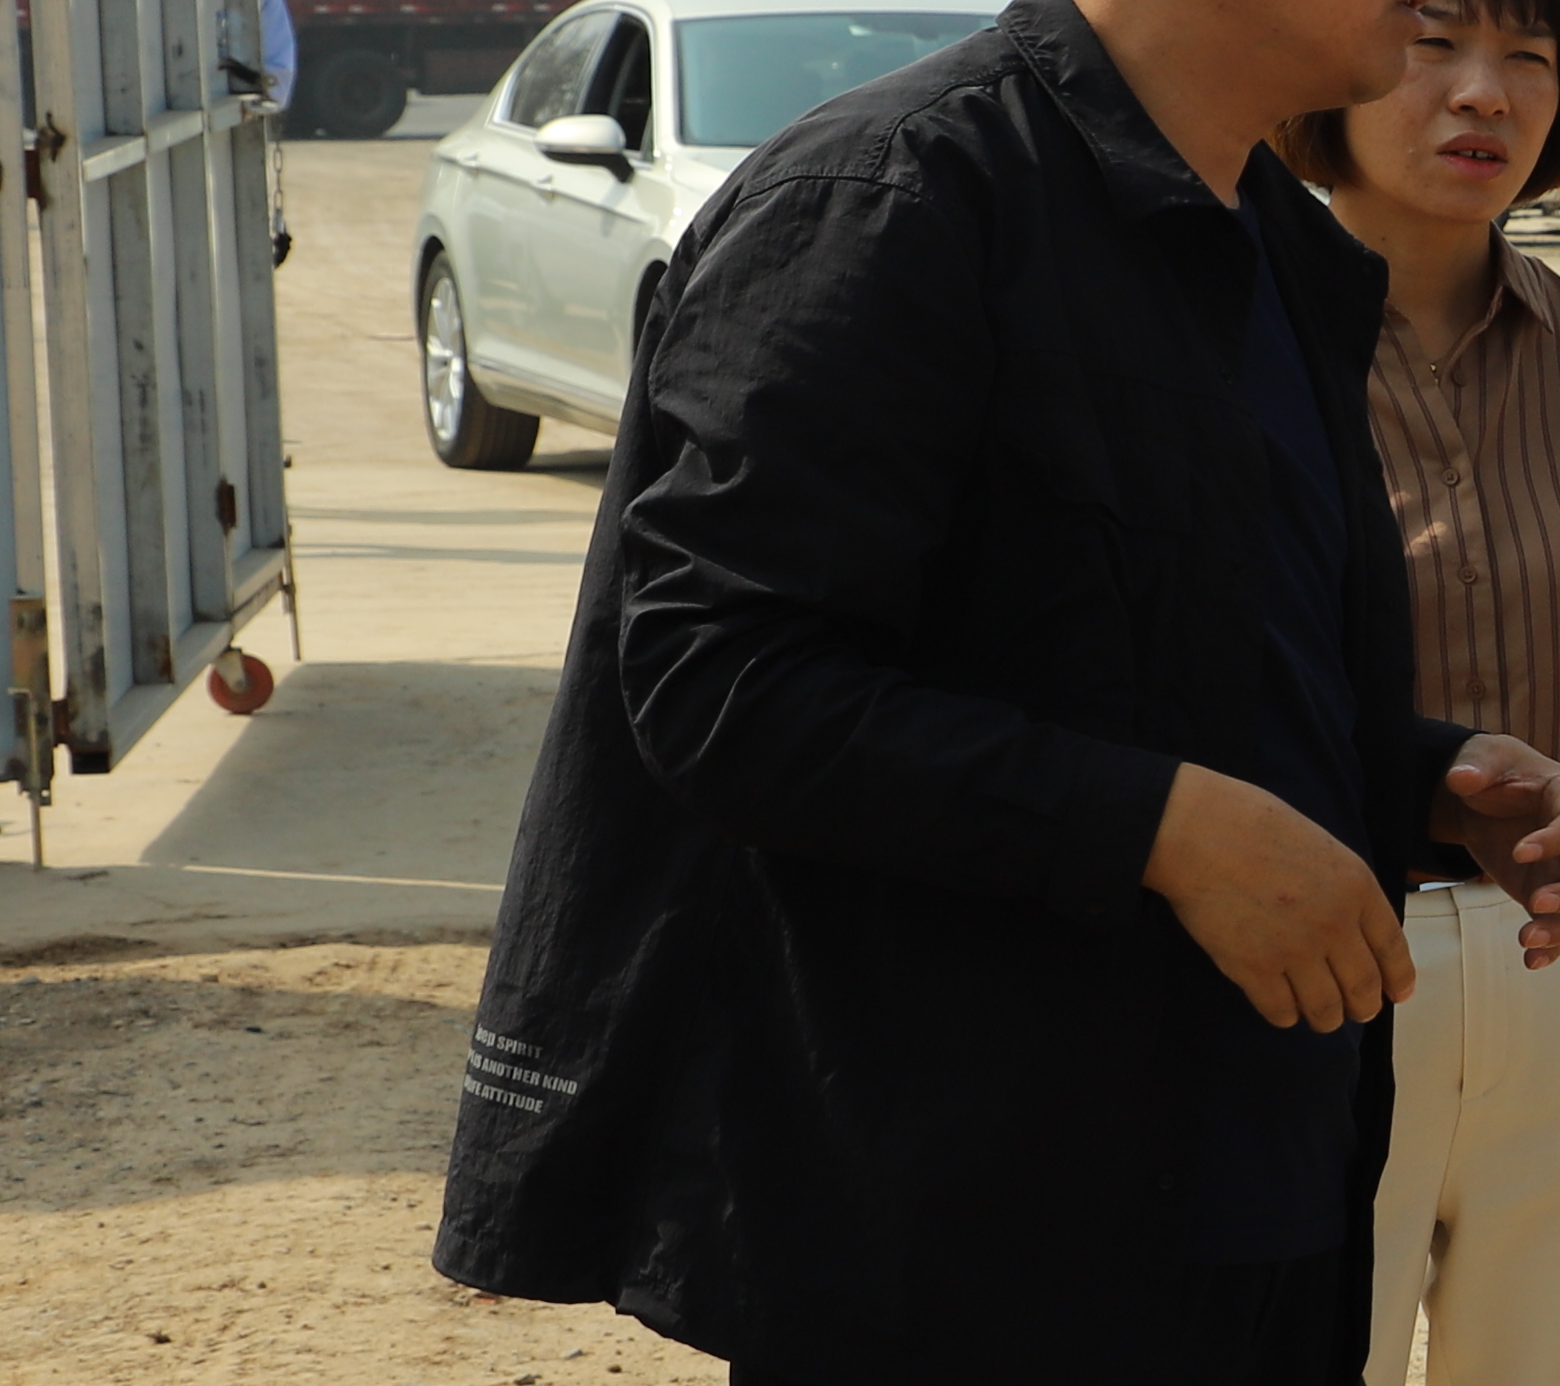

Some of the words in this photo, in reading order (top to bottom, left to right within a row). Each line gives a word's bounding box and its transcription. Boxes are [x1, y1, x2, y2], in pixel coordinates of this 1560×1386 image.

[497, 1034, 543, 1059] SPIRIT
[481, 1058, 540, 1086] ANOTHER
[542, 1074, 578, 1096] KIND
[481, 1083, 544, 1114] ATTITUDE
